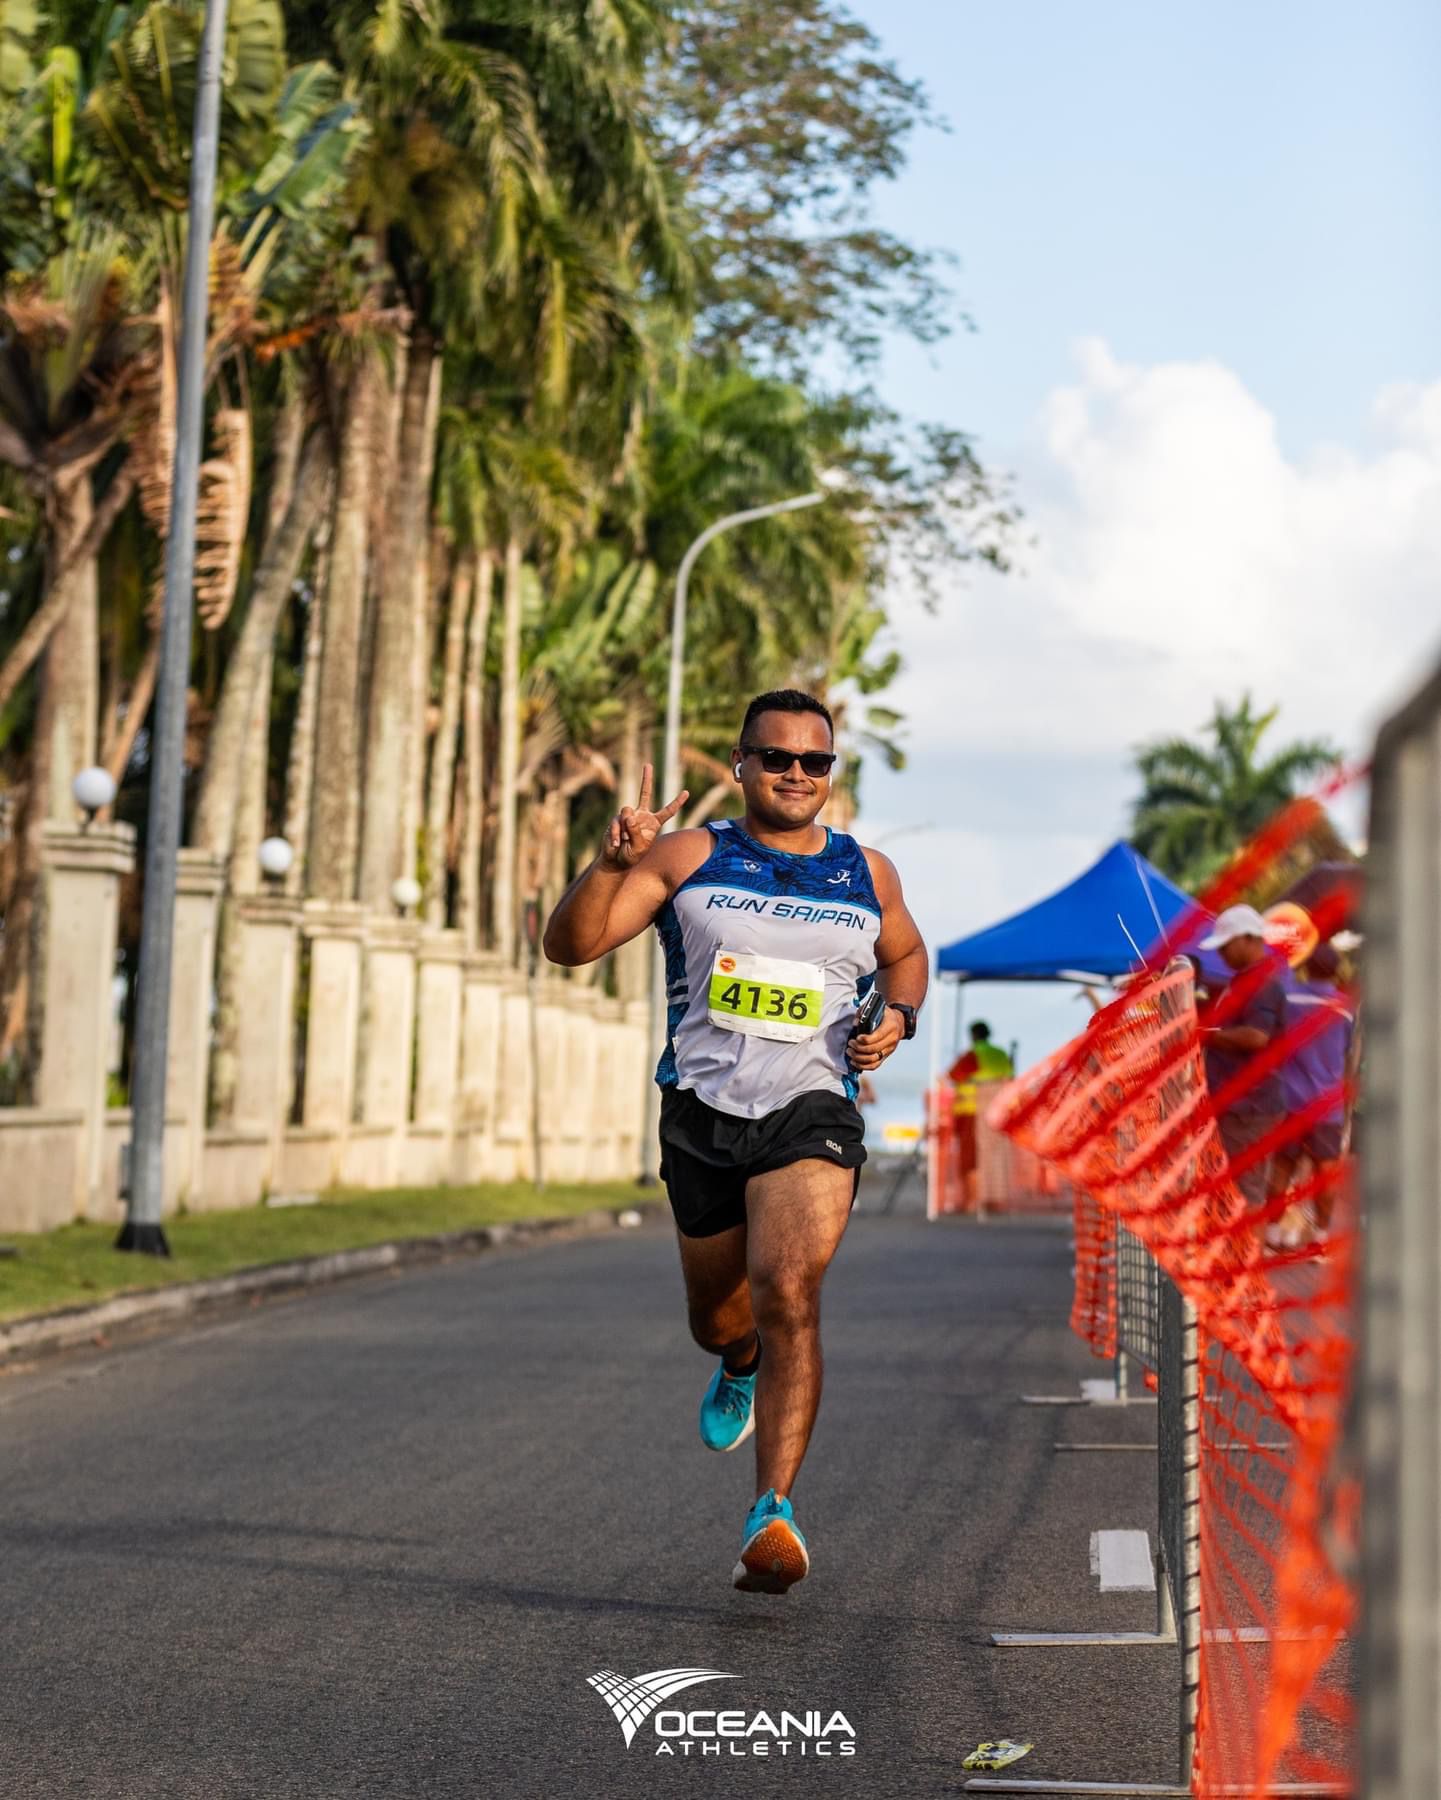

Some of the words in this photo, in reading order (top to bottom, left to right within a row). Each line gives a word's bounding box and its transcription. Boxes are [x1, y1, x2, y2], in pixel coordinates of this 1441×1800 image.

[706, 894, 768, 913] RUN
[772, 903, 865, 931] SAIPAN
[720, 982, 808, 1020] 4136
